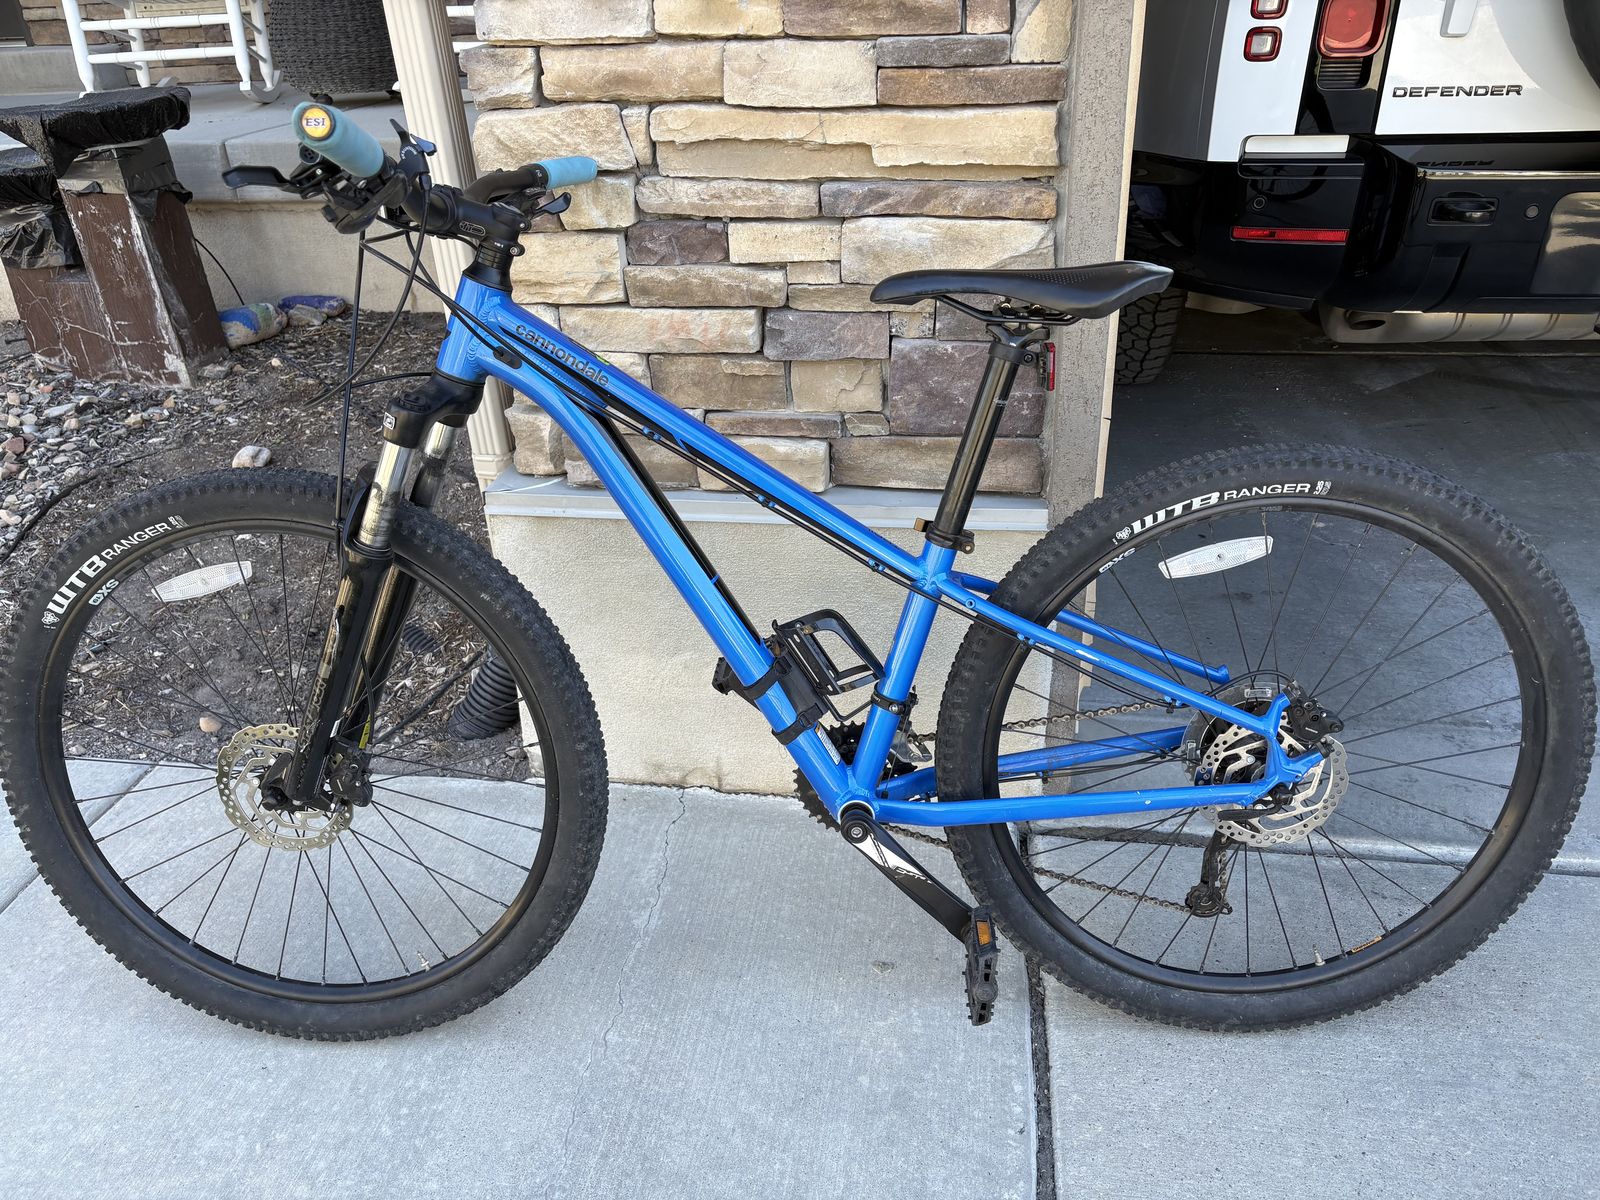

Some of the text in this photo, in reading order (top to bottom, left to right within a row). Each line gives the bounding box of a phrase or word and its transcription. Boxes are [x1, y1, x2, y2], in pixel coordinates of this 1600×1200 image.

[1392, 84, 1523, 98] DEFENDER
[305, 117, 326, 127] ESI
[515, 324, 609, 386] cannondale
[1131, 491, 1220, 535] WTB
[1224, 483, 1311, 500] RANGER
[46, 522, 172, 614] WTB RANGER
